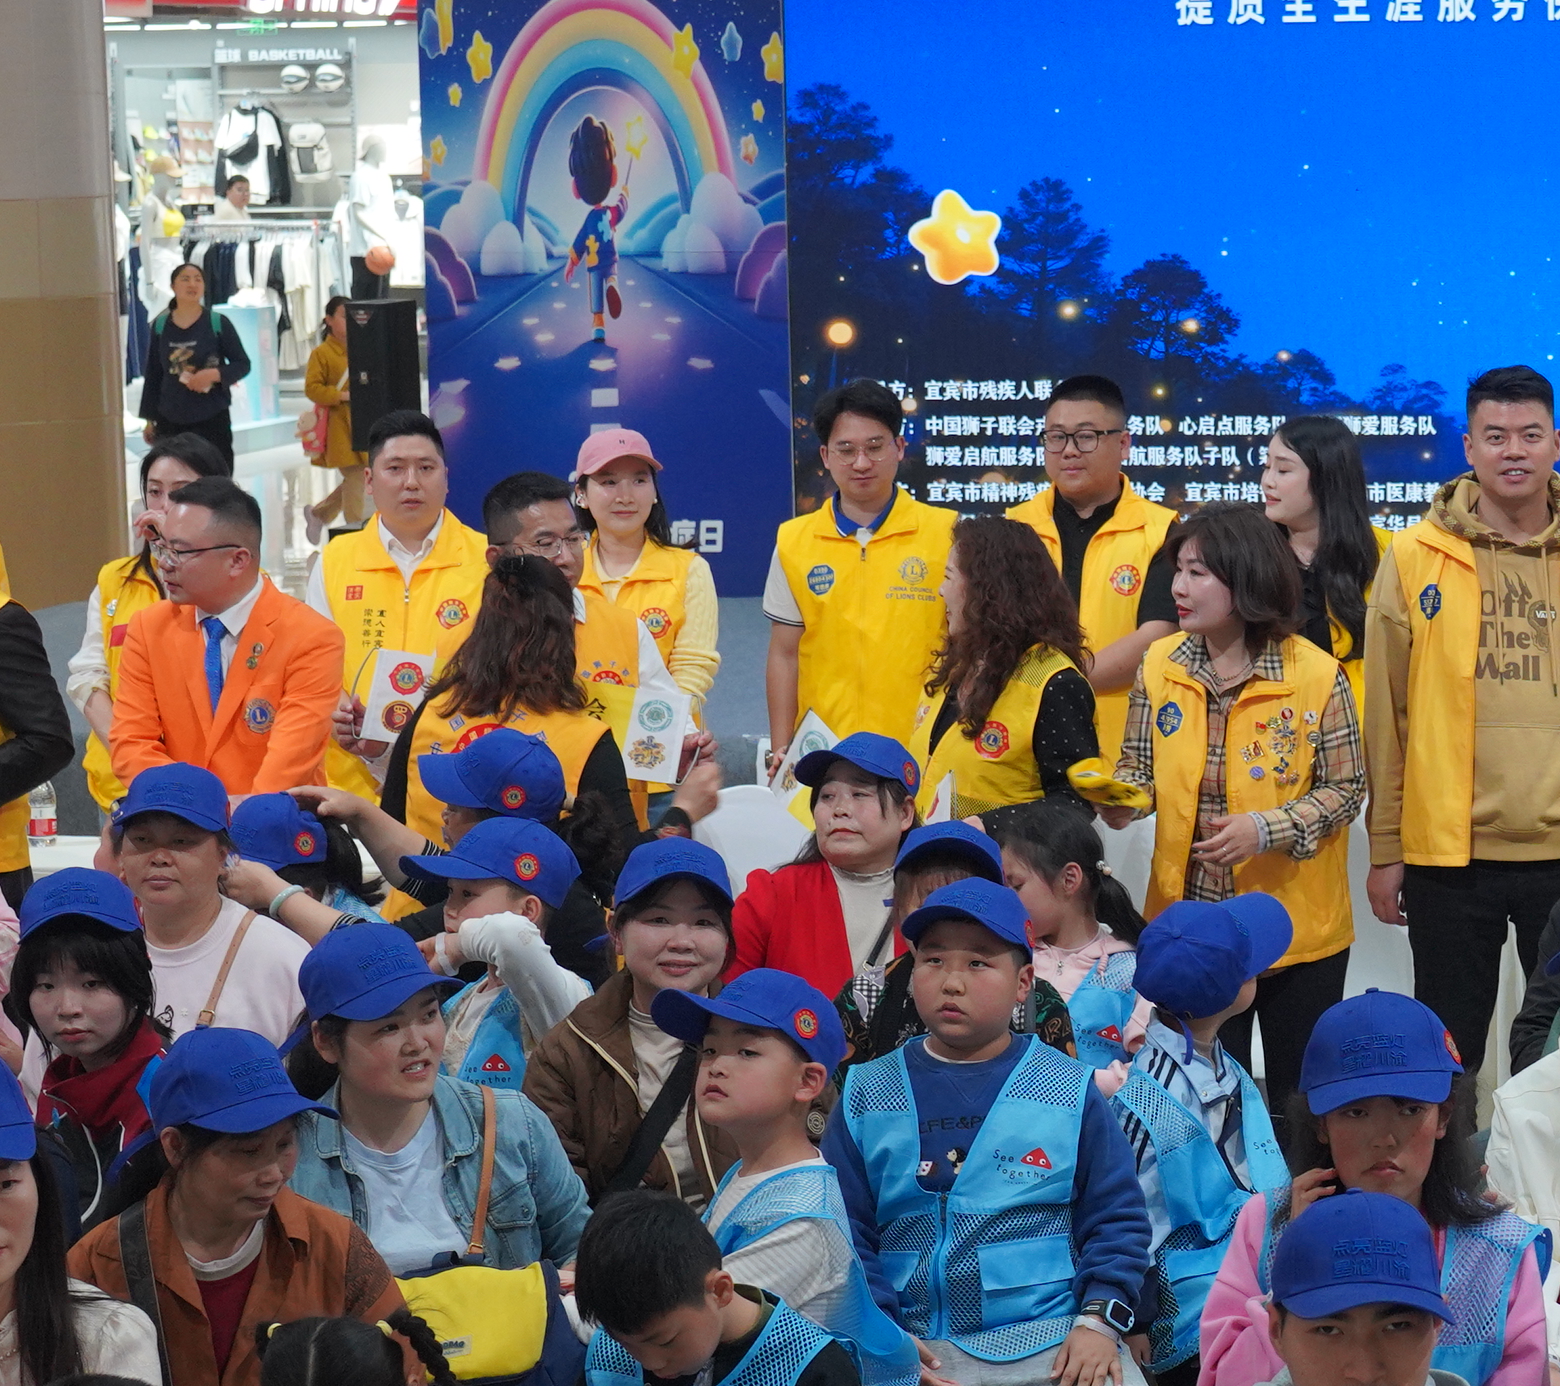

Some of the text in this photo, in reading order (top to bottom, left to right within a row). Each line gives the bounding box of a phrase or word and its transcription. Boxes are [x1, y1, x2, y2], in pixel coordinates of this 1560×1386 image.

[248, 47, 342, 62] BASKETBALL
[1477, 622, 1530, 651] The
[1475, 652, 1541, 682] Wall
[1074, 1023, 1093, 1034] See
[993, 1150, 1015, 1163] See
[996, 1163, 1051, 1181] together
